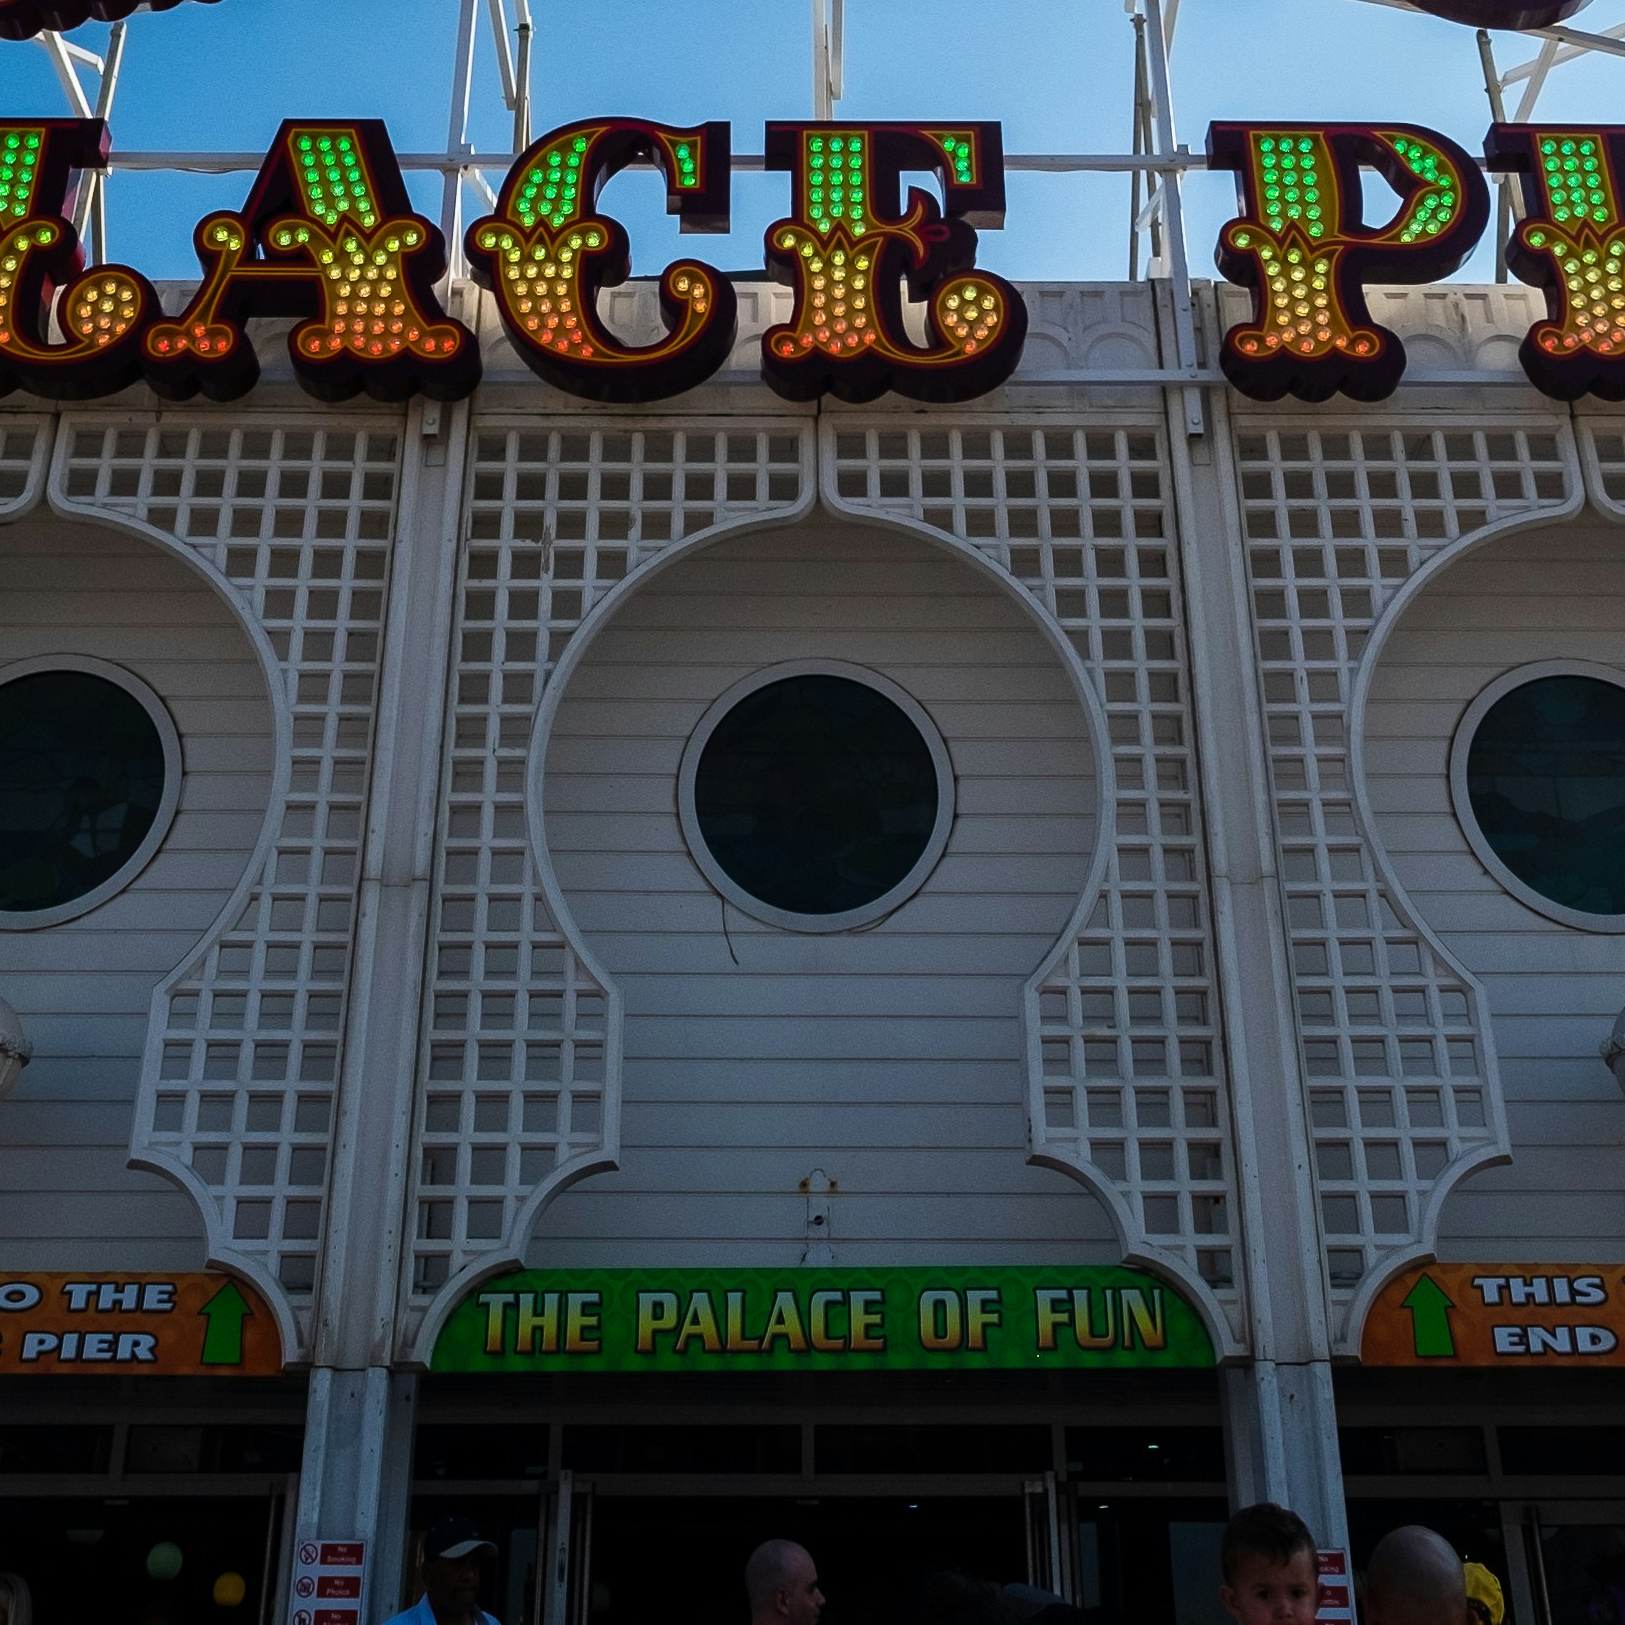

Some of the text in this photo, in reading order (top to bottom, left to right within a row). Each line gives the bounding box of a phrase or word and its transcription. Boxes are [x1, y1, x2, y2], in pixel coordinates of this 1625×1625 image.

[63, 1282, 176, 1313] THE
[1472, 1276, 1607, 1306] THIS
[478, 1288, 1167, 1354] THE PALACE OF FUN
[21, 1332, 157, 1363] PIER
[1492, 1326, 1617, 1356] END
